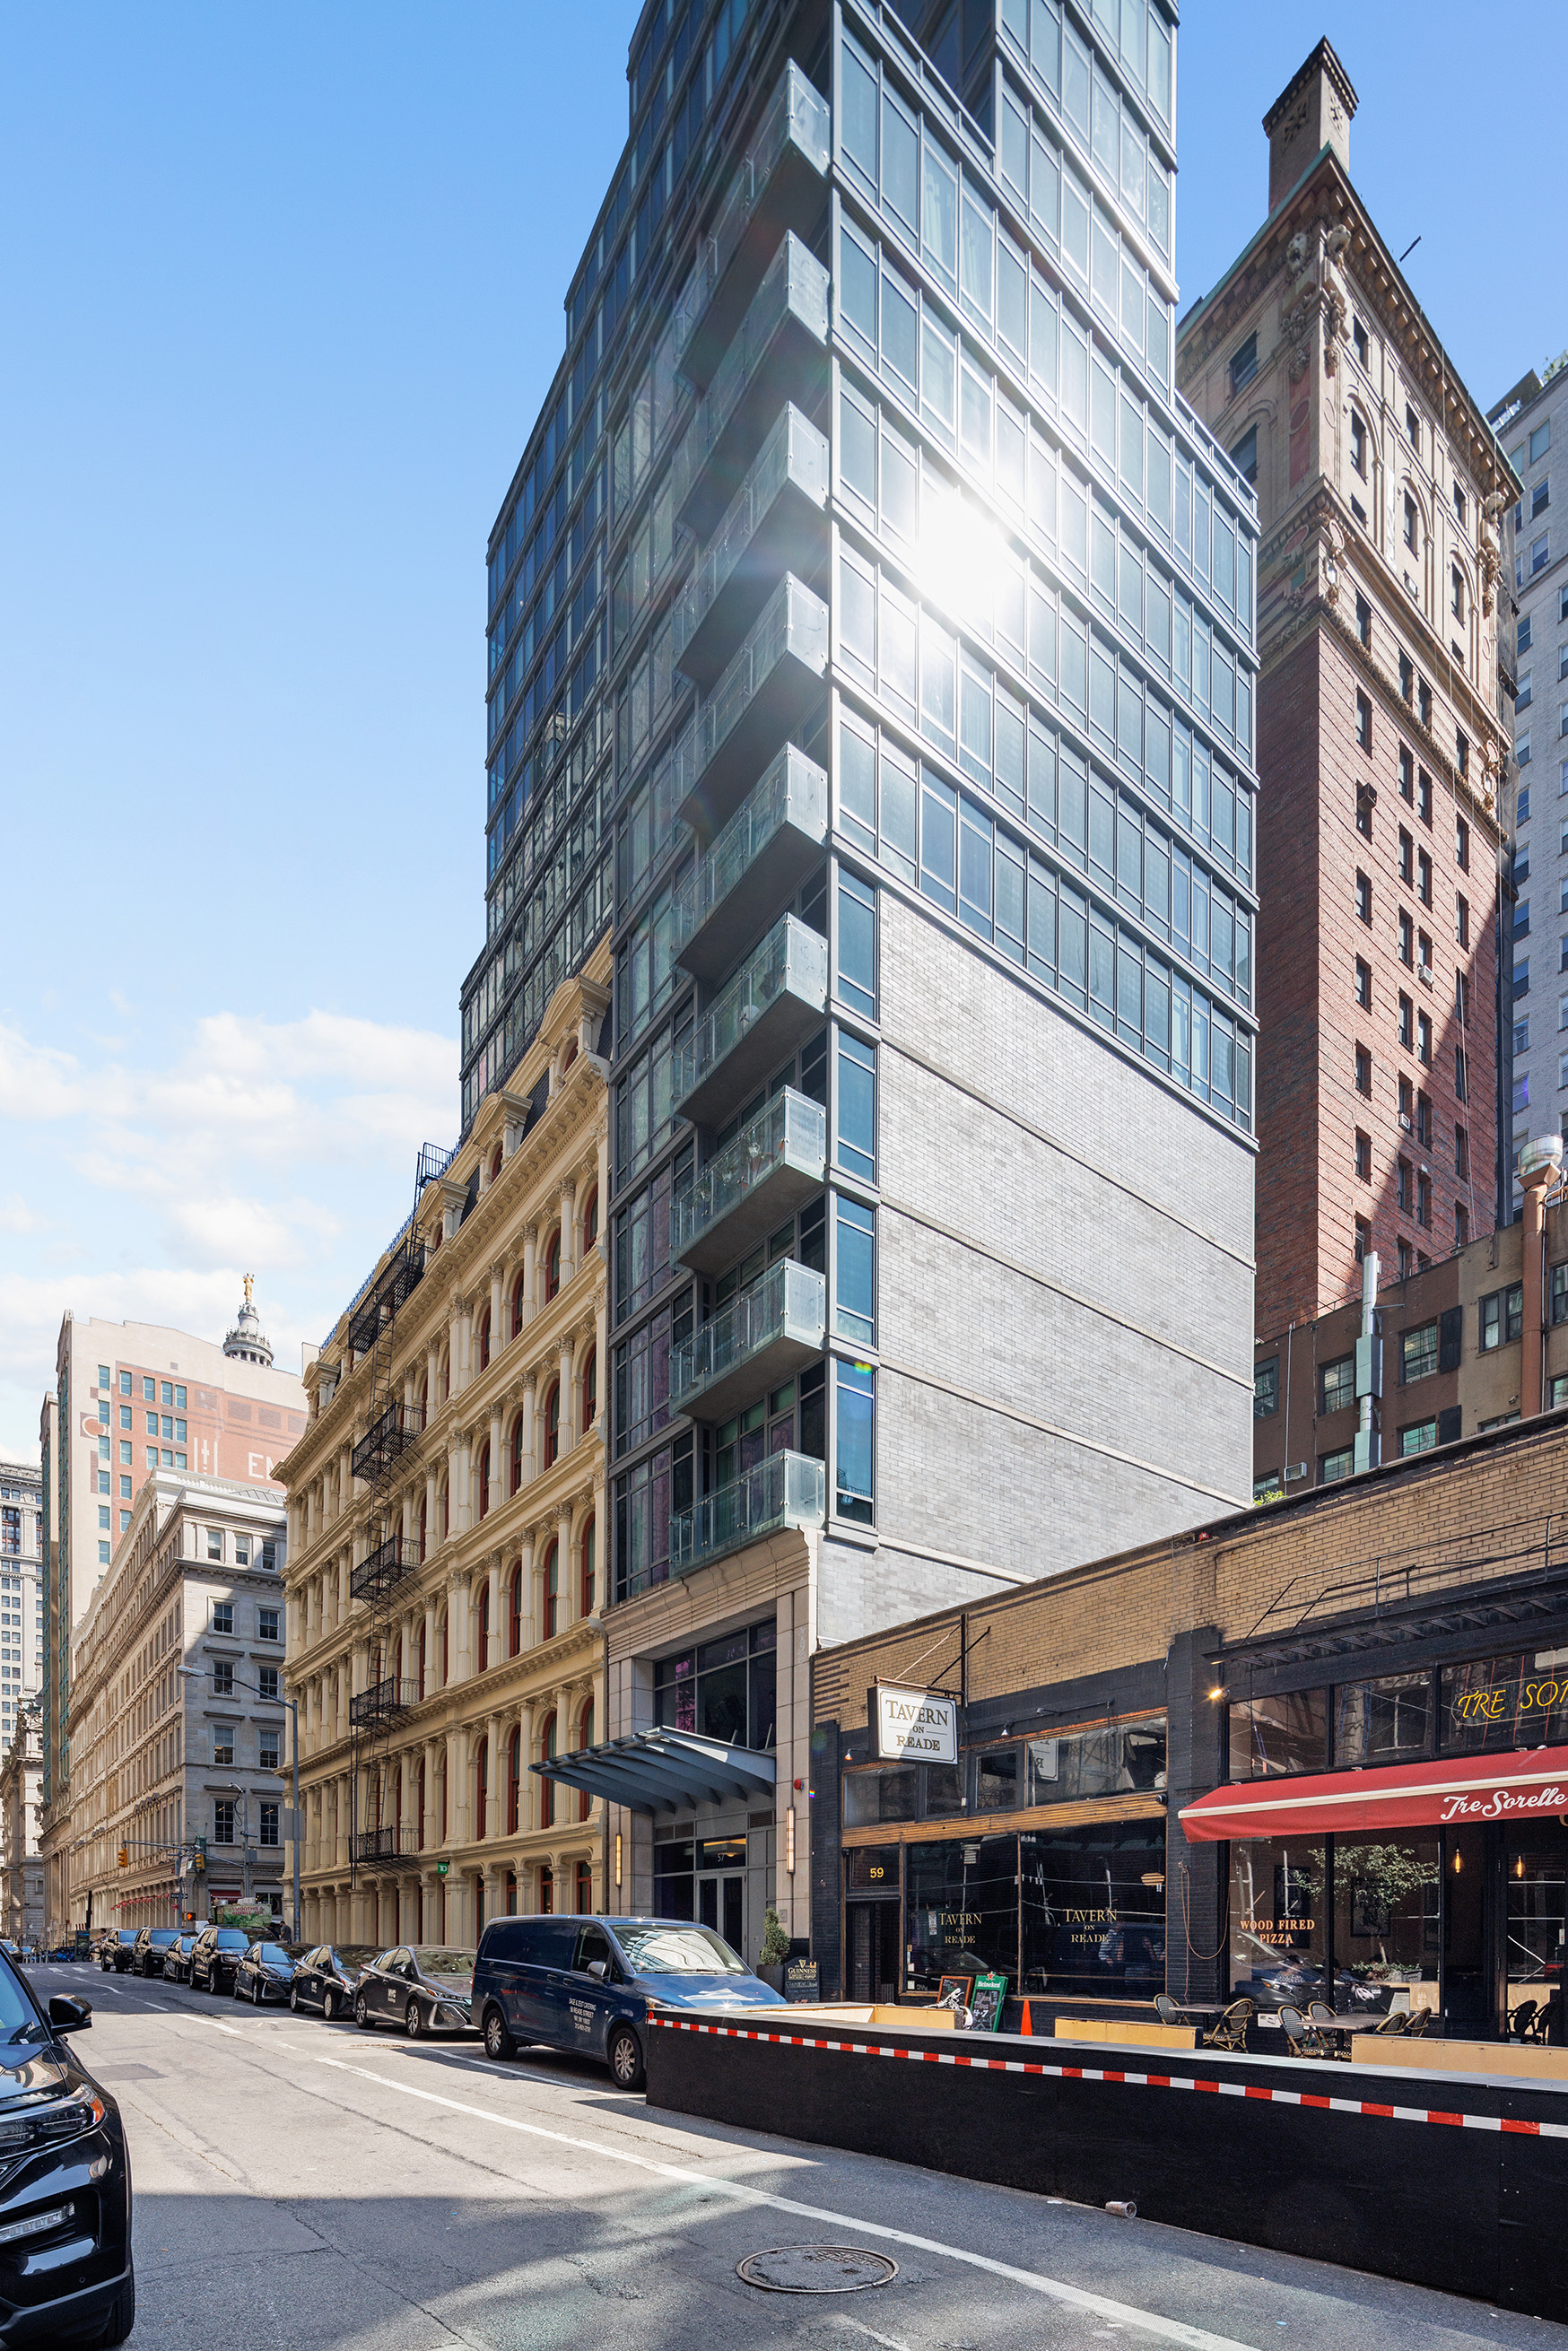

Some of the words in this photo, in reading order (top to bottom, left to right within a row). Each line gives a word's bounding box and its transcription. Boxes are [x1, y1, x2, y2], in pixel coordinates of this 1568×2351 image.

[1458, 1689, 1506, 1719] TRE
[884, 1699, 948, 1727] TAVERN
[912, 1725, 925, 1734] ON
[896, 1735, 941, 1752] READE
[1440, 1794, 1483, 1821] Tre
[1481, 1787, 1568, 1817] Sorelle
[870, 1867, 884, 1878] 59
[938, 1912, 982, 1925] TAVERN
[1063, 1909, 1117, 1922] TAVERN
[1240, 1920, 1274, 1930] WOOD
[1278, 1920, 1315, 1930] FIRED
[945, 1936, 976, 1944] READE
[1071, 1934, 1109, 1943] READE
[1259, 1933, 1294, 1944] PIZZA
